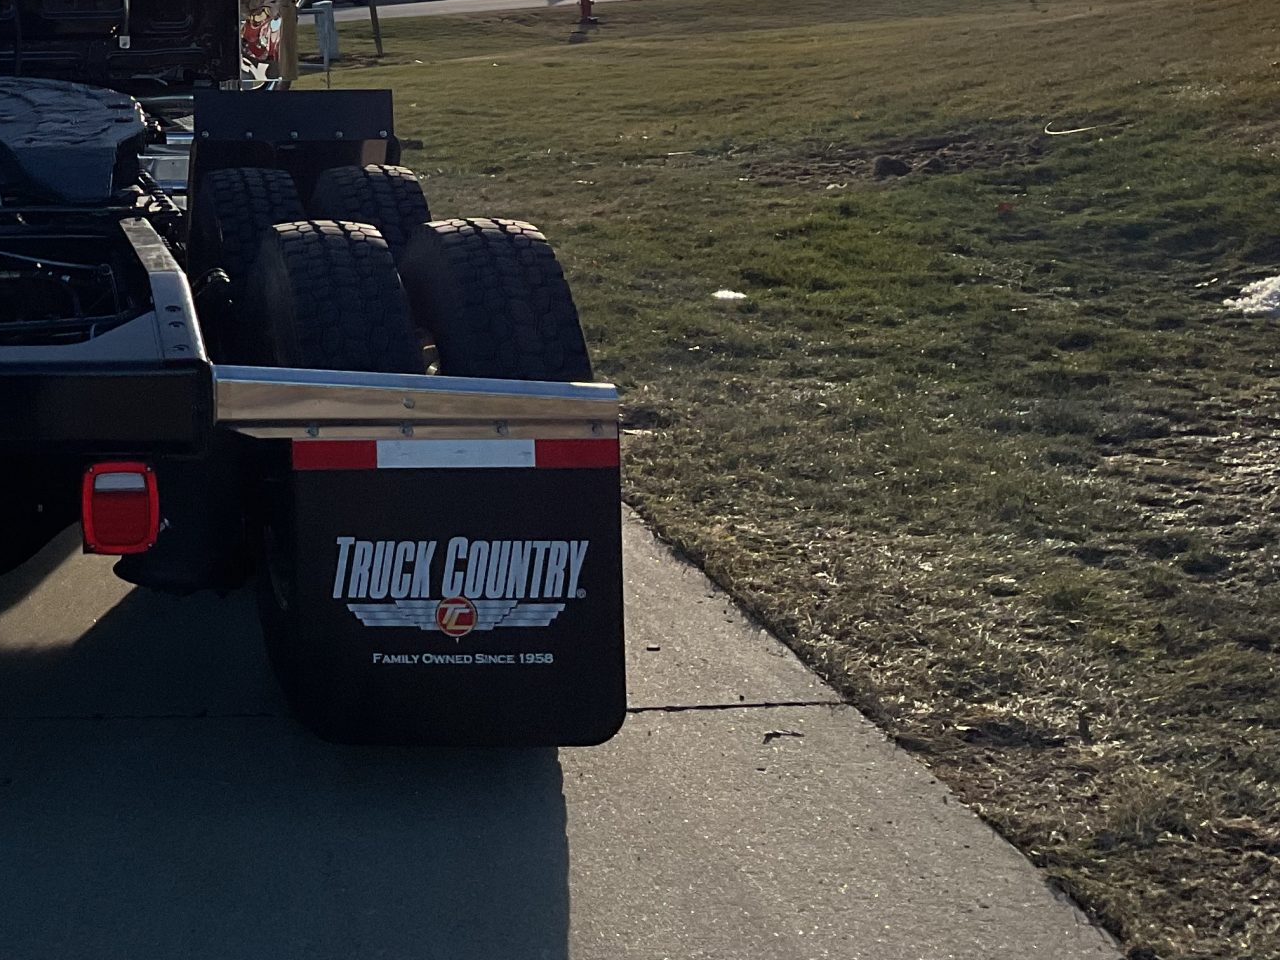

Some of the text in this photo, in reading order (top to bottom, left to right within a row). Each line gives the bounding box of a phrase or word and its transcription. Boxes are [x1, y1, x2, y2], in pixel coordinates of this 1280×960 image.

[332, 536, 590, 599] TRUCK COUNTRY
[372, 652, 554, 665] FAMILY OWNED SINCE 1958
